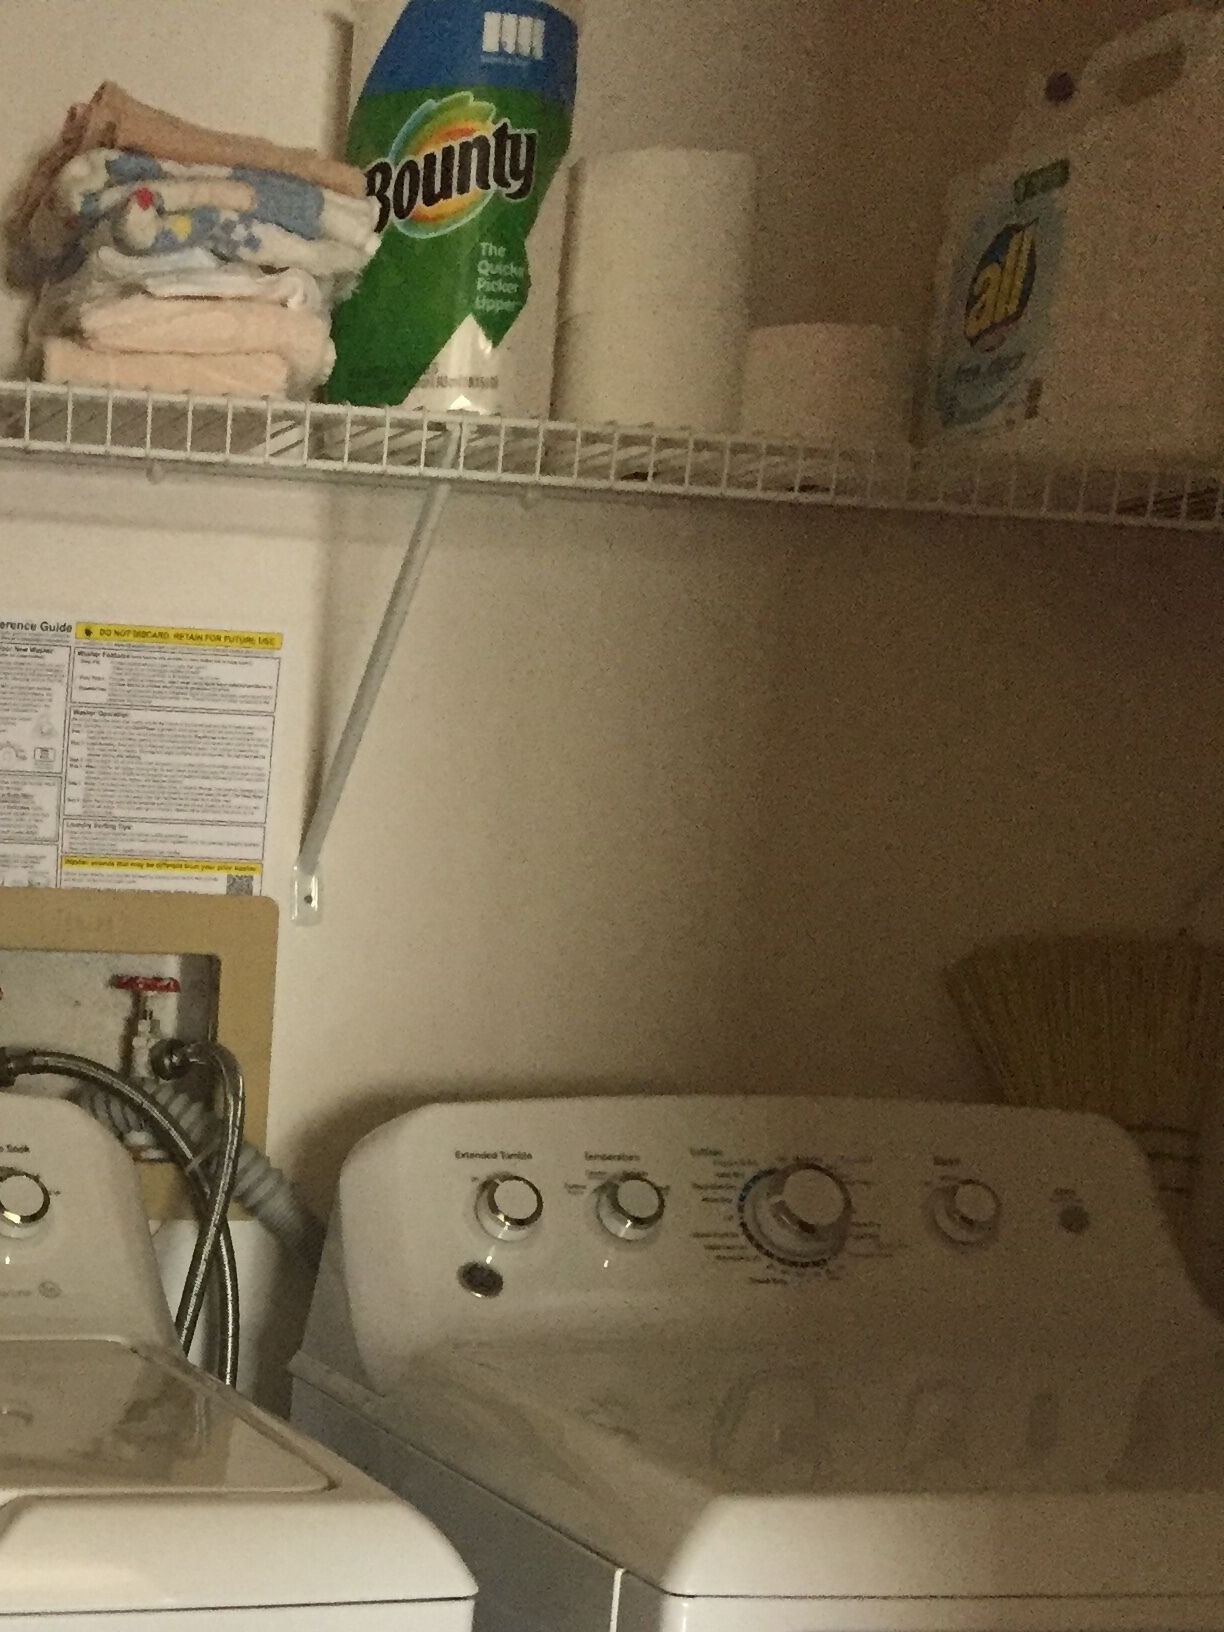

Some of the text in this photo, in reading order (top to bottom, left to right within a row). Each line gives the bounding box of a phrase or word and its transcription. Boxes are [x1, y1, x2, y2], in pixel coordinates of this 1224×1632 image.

[366, 121, 538, 233] Bounty
[480, 242, 506, 257] The
[476, 277, 519, 293] Picker
[965, 222, 1039, 341] all
[40, 621, 73, 633] Guide
[99, 628, 112, 637] DO
[114, 629, 131, 638] NOT
[454, 1150, 499, 1161] Extended
